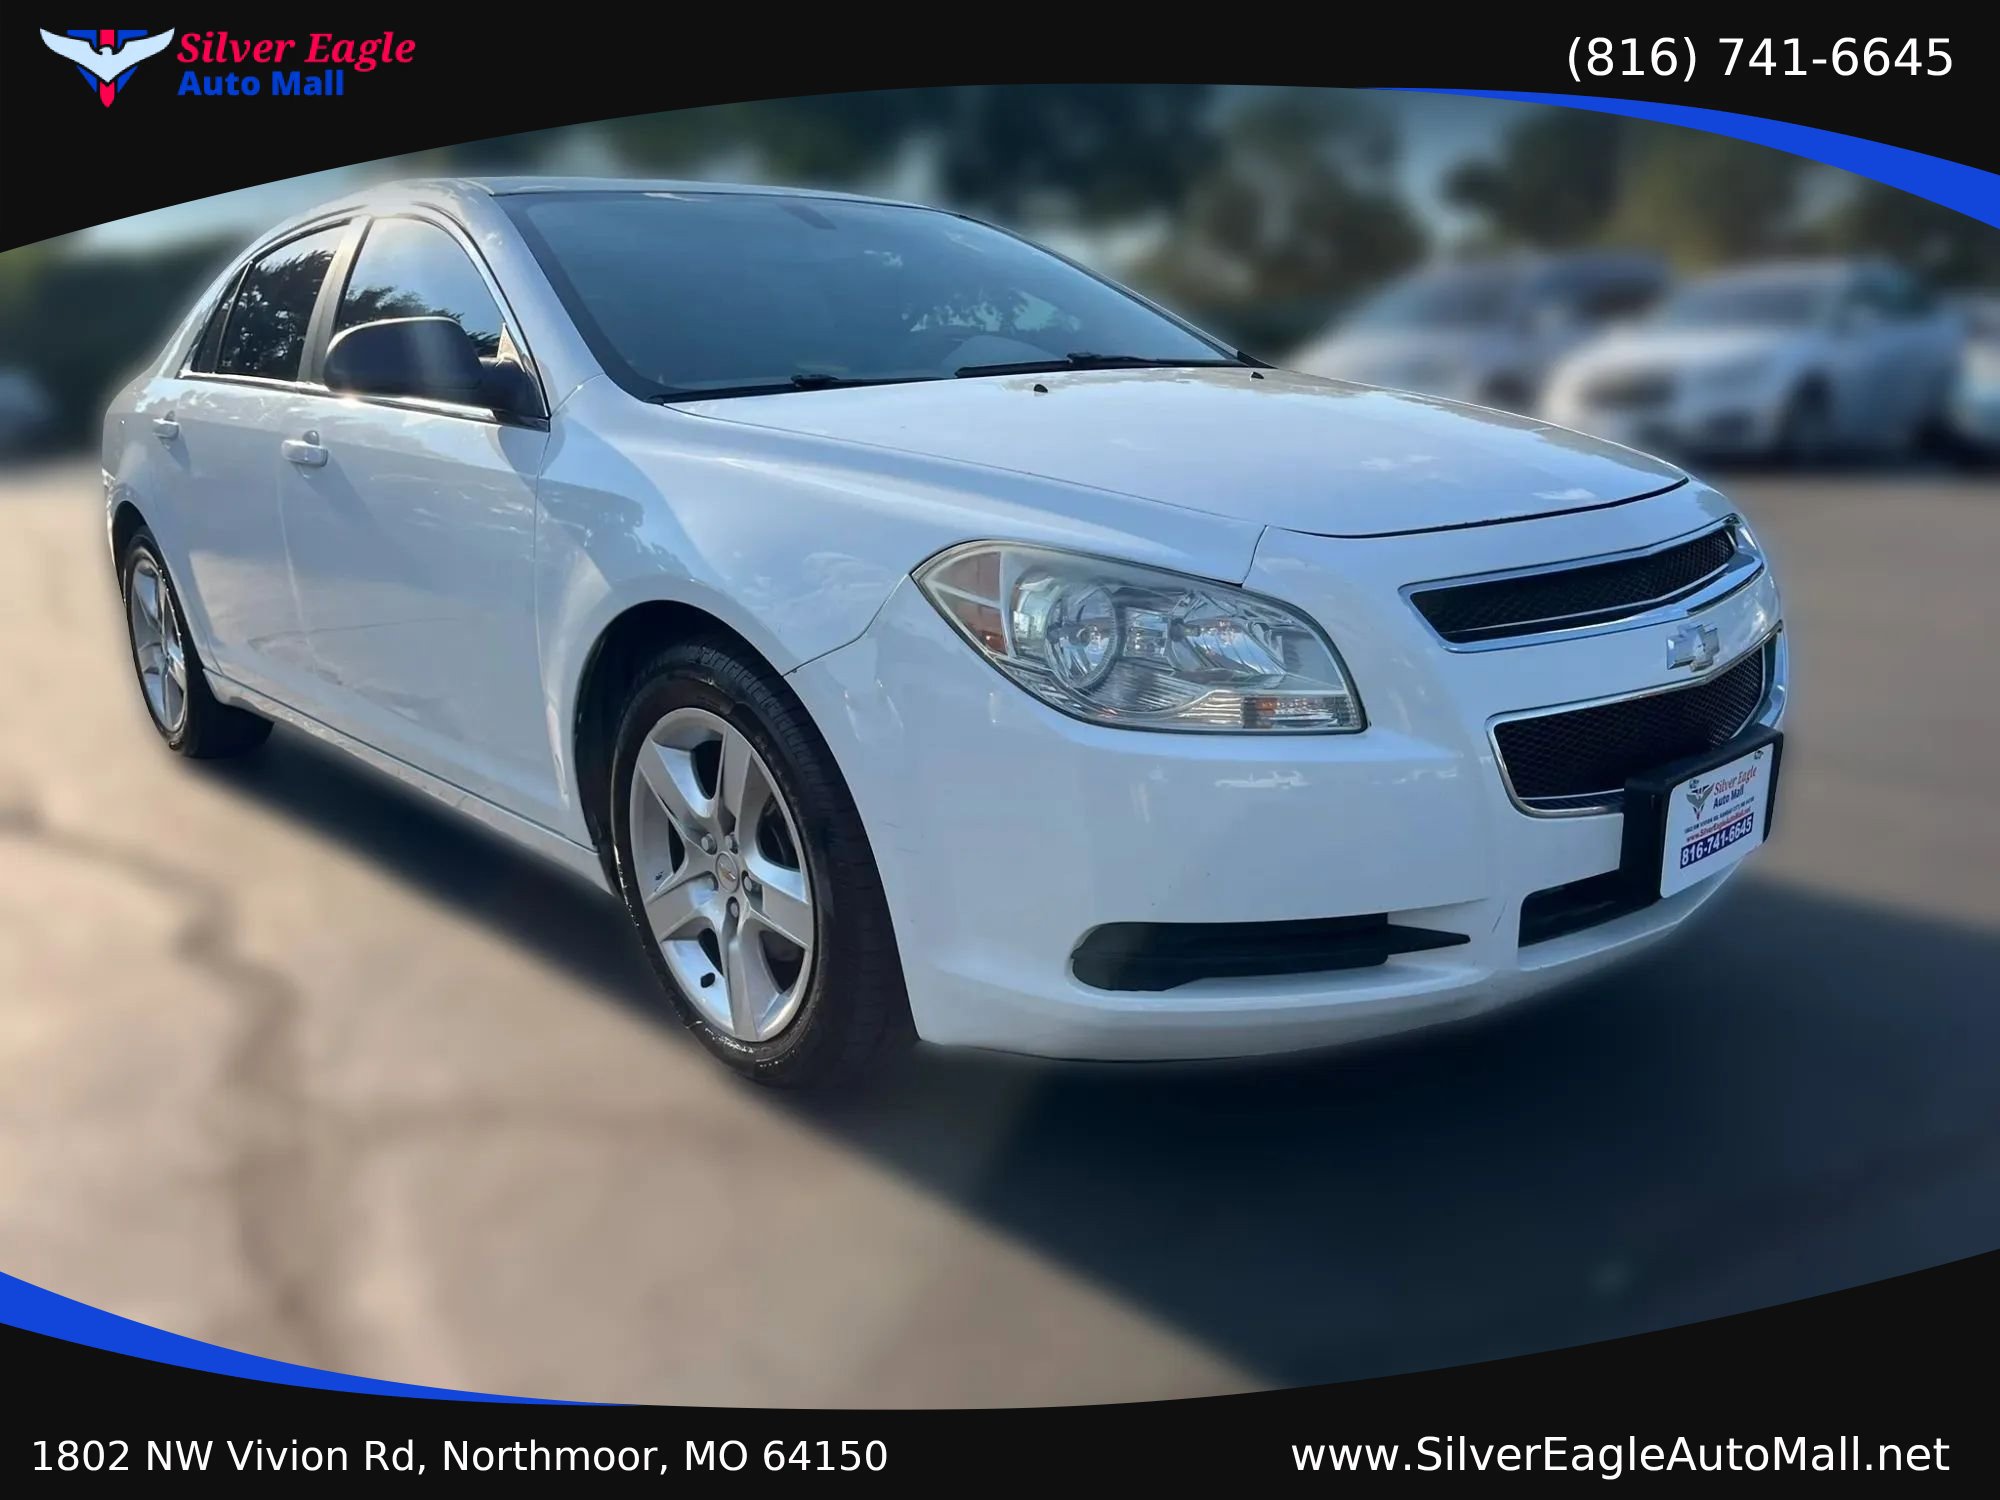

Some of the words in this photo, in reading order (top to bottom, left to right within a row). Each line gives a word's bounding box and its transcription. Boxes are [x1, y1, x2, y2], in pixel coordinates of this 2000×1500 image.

[1714, 775, 1738, 795] Silver
[1738, 765, 1757, 785] Eagle
[1713, 793, 1730, 809] Auto
[1731, 784, 1745, 801] Mall
[1681, 815, 1752, 866] 816-741-6645
